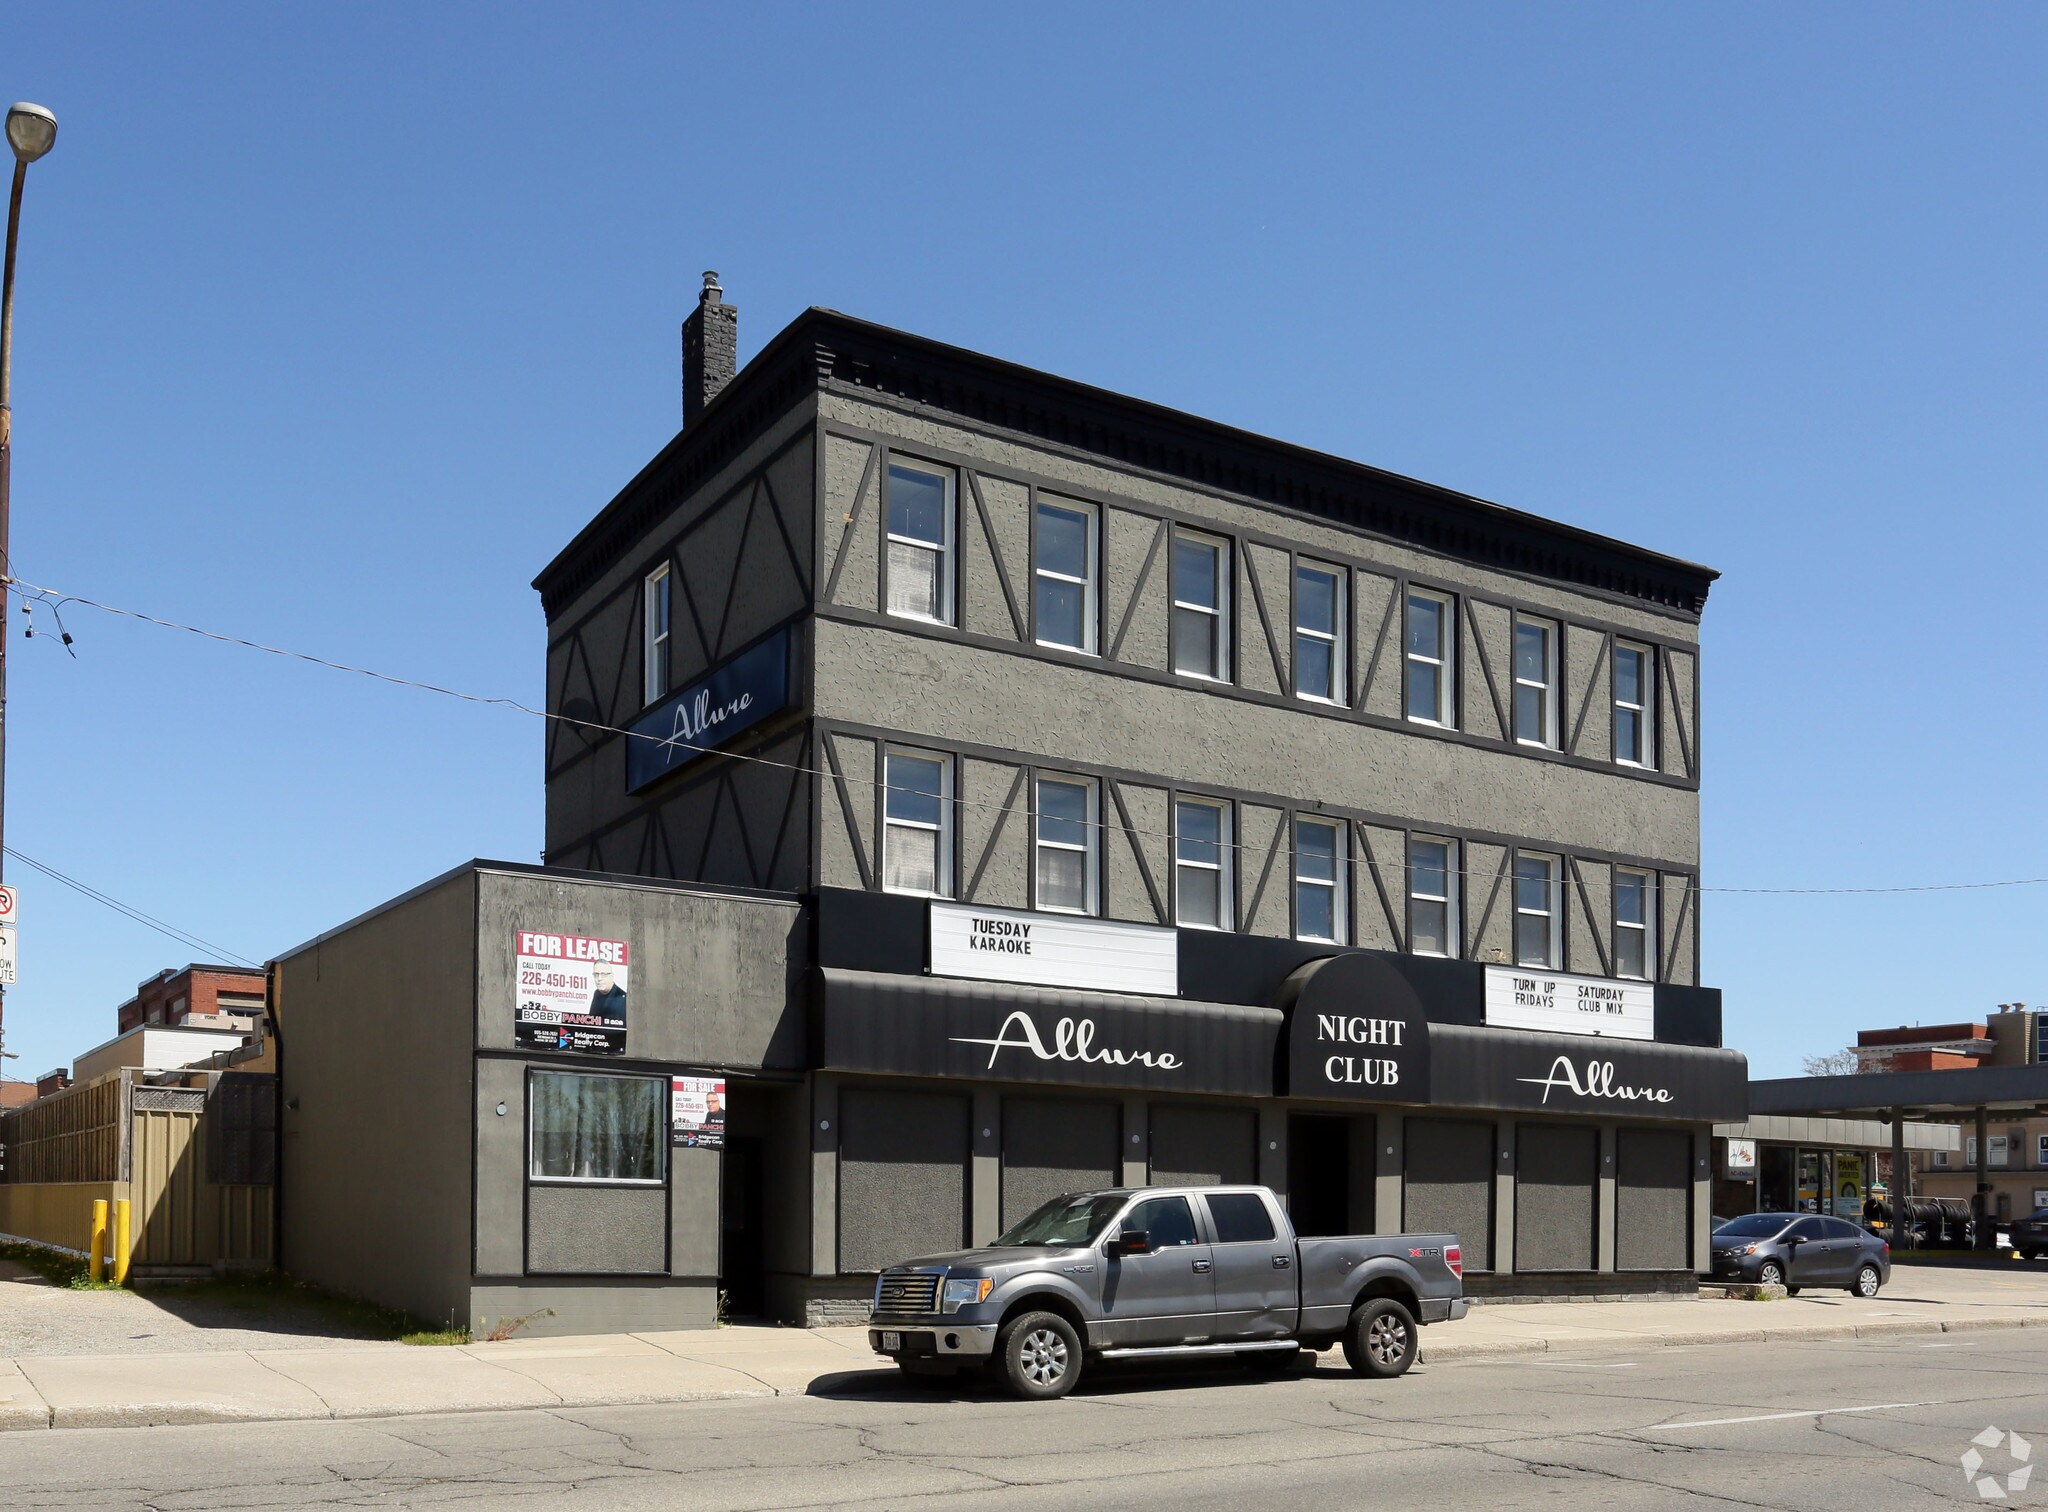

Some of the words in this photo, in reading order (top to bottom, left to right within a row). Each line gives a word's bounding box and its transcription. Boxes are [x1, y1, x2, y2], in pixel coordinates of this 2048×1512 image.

[656, 689, 753, 764] Allure
[972, 918, 1032, 938] TUESDAY
[522, 933, 561, 957] FOR
[566, 938, 623, 963] LEASE
[970, 935, 1032, 955] KARAOKE
[522, 962, 535, 970] CALL
[535, 963, 551, 971] TODAY
[522, 971, 588, 990] 226-450-1611
[1513, 978, 1536, 992] TURN
[1544, 982, 1556, 994] UP
[522, 988, 588, 1000] www.bobbypanchi.com
[1515, 992, 1554, 1008] FRIDAYS
[1578, 985, 1624, 1001] SATURDAY
[1578, 999, 1601, 1013] CLUB
[1606, 1002, 1624, 1015] MIX
[523, 1011, 560, 1022] BOBBY
[562, 1013, 602, 1026] PANCHI
[1317, 1014, 1406, 1046] NIGHT
[574, 1039, 593, 1047] Realty
[593, 1039, 610, 1048] Corp.
[948, 1011, 1183, 1070] Allure
[1325, 1056, 1399, 1085] CLUB
[683, 1082, 697, 1092] FOR
[698, 1083, 715, 1093] SALE
[1516, 1055, 1674, 1104] Allure
[1838, 1160, 1859, 1170] PANIC
[1408, 1247, 1442, 1258] XTR
